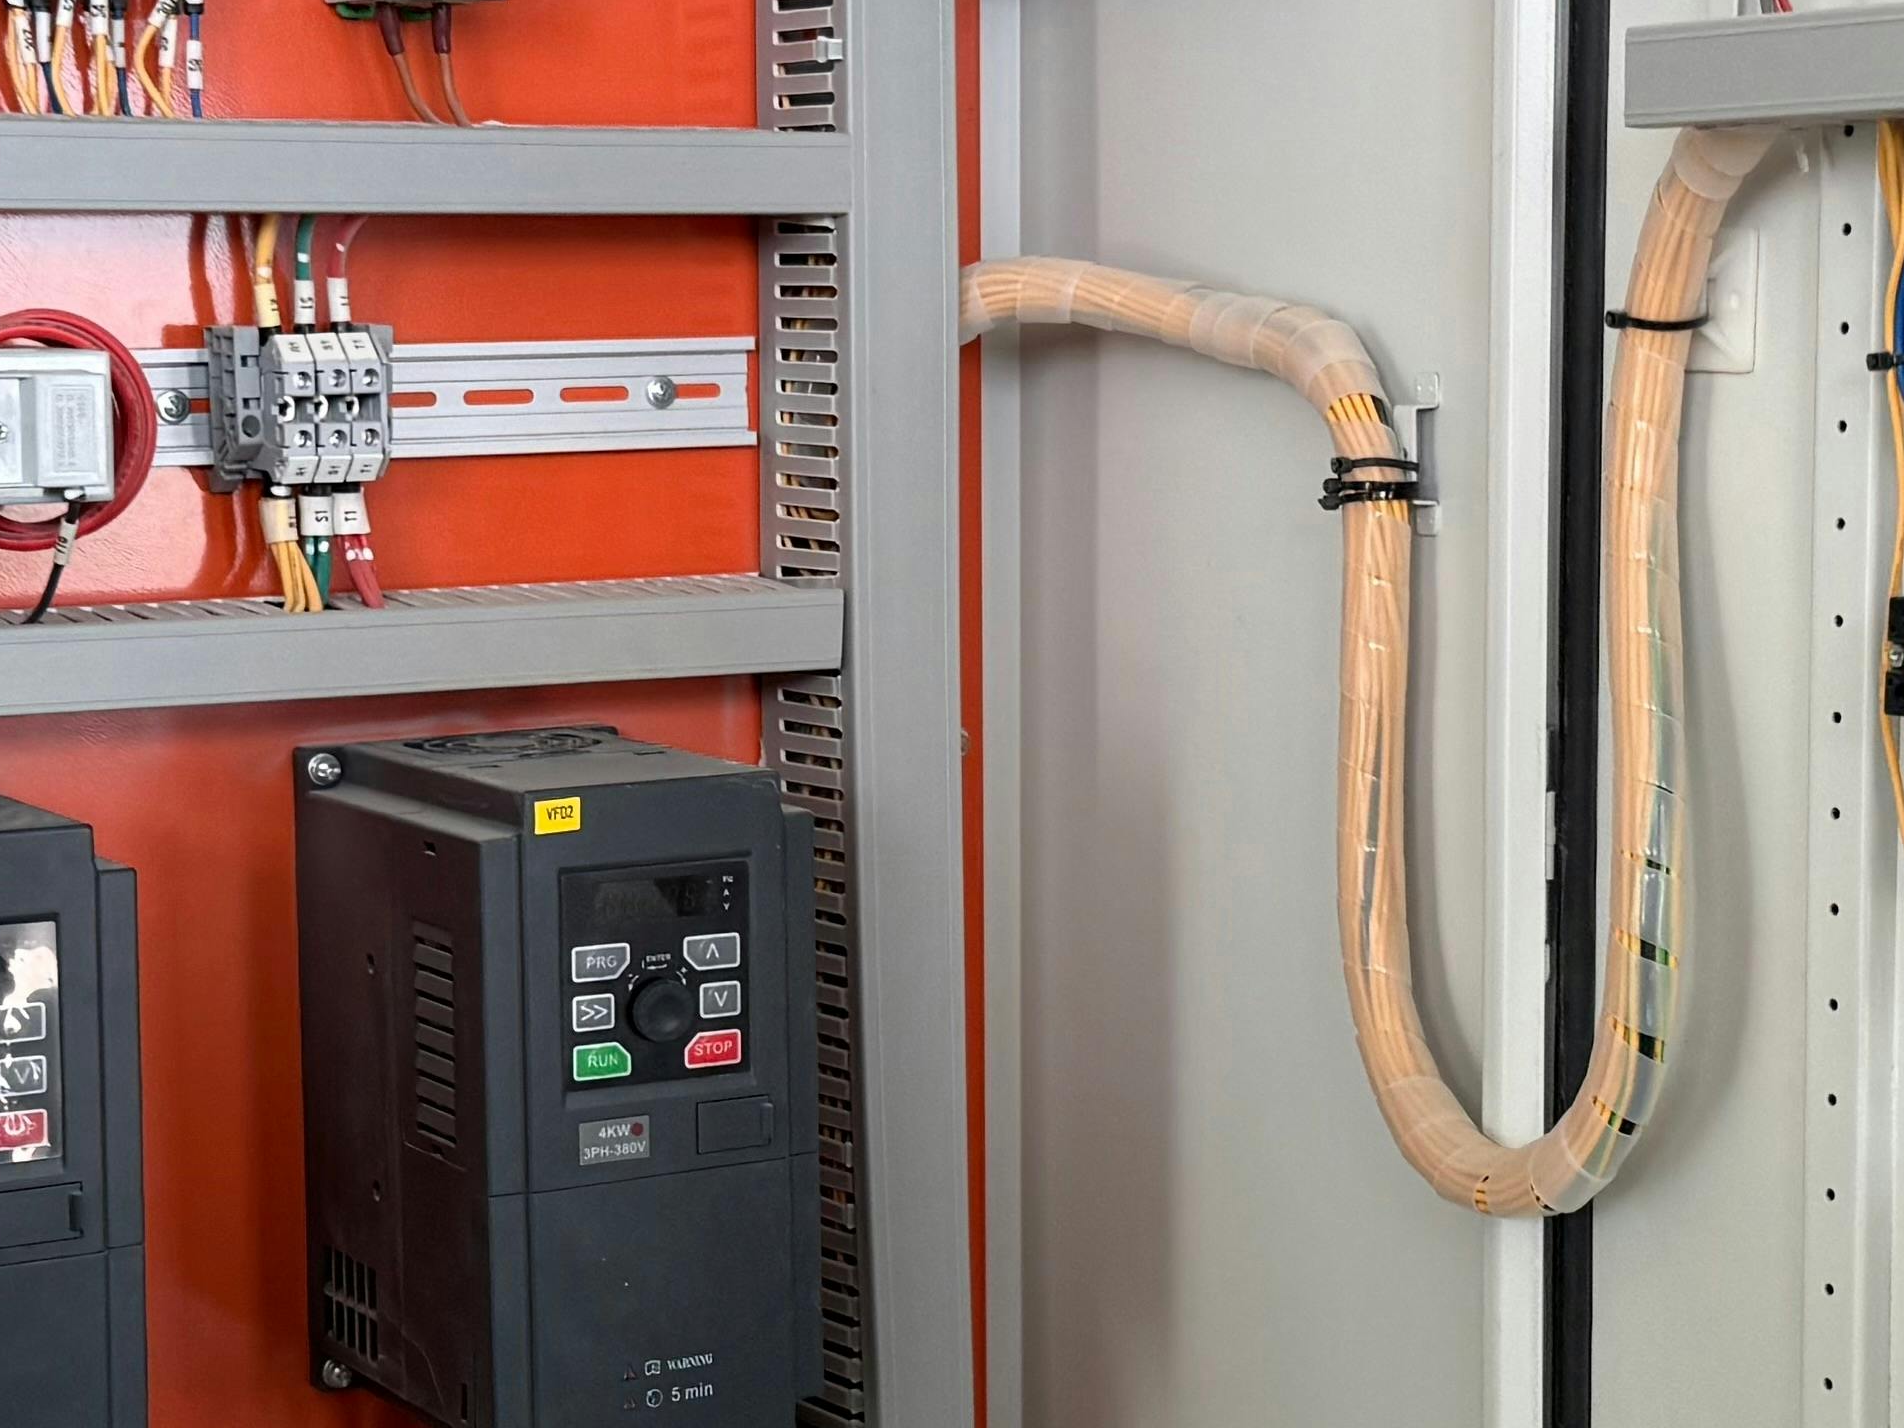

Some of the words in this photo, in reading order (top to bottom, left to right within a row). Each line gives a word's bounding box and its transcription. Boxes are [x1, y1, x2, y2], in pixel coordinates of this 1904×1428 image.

[314, 508, 329, 523] S1
[344, 508, 358, 523] T1
[546, 805, 575, 820] VFD2
[586, 954, 618, 970] PRG
[694, 1040, 734, 1056] STOP
[587, 1052, 619, 1068] RUN
[598, 1125, 631, 1139] 4KW
[583, 1141, 647, 1159] 3PH-380V
[671, 1387, 681, 1402] 5
[685, 1382, 713, 1400] min
